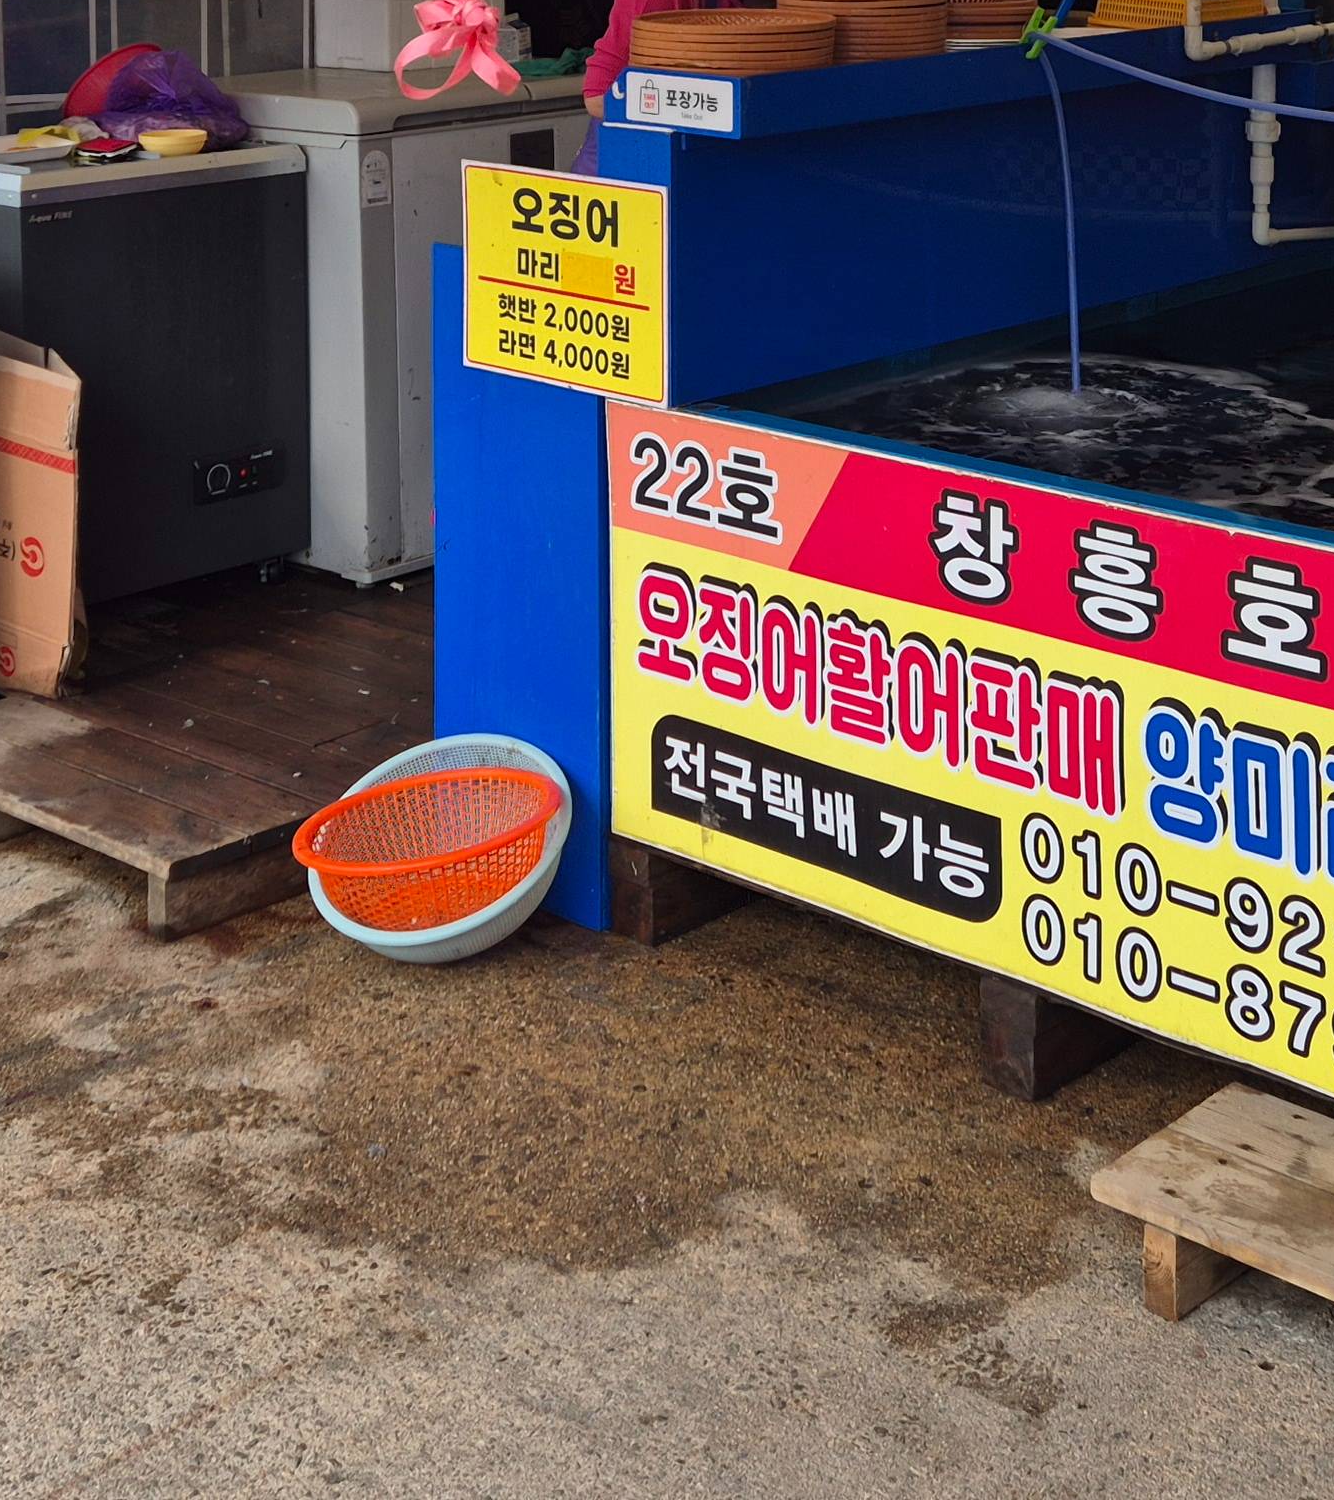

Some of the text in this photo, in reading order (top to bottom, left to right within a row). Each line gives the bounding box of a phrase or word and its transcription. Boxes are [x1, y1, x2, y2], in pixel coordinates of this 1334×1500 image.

[666, 89, 718, 112] 포장가능
[510, 186, 620, 248] 오징어
[516, 247, 637, 297] 마리 원
[497, 293, 631, 344] 햇반 2,000원
[497, 328, 631, 381] 라면 4,000원
[628, 430, 784, 547] 22호
[634, 561, 1127, 821] 오징어활어판매
[663, 734, 858, 859] 전국택배
[878, 811, 992, 900] 가능
